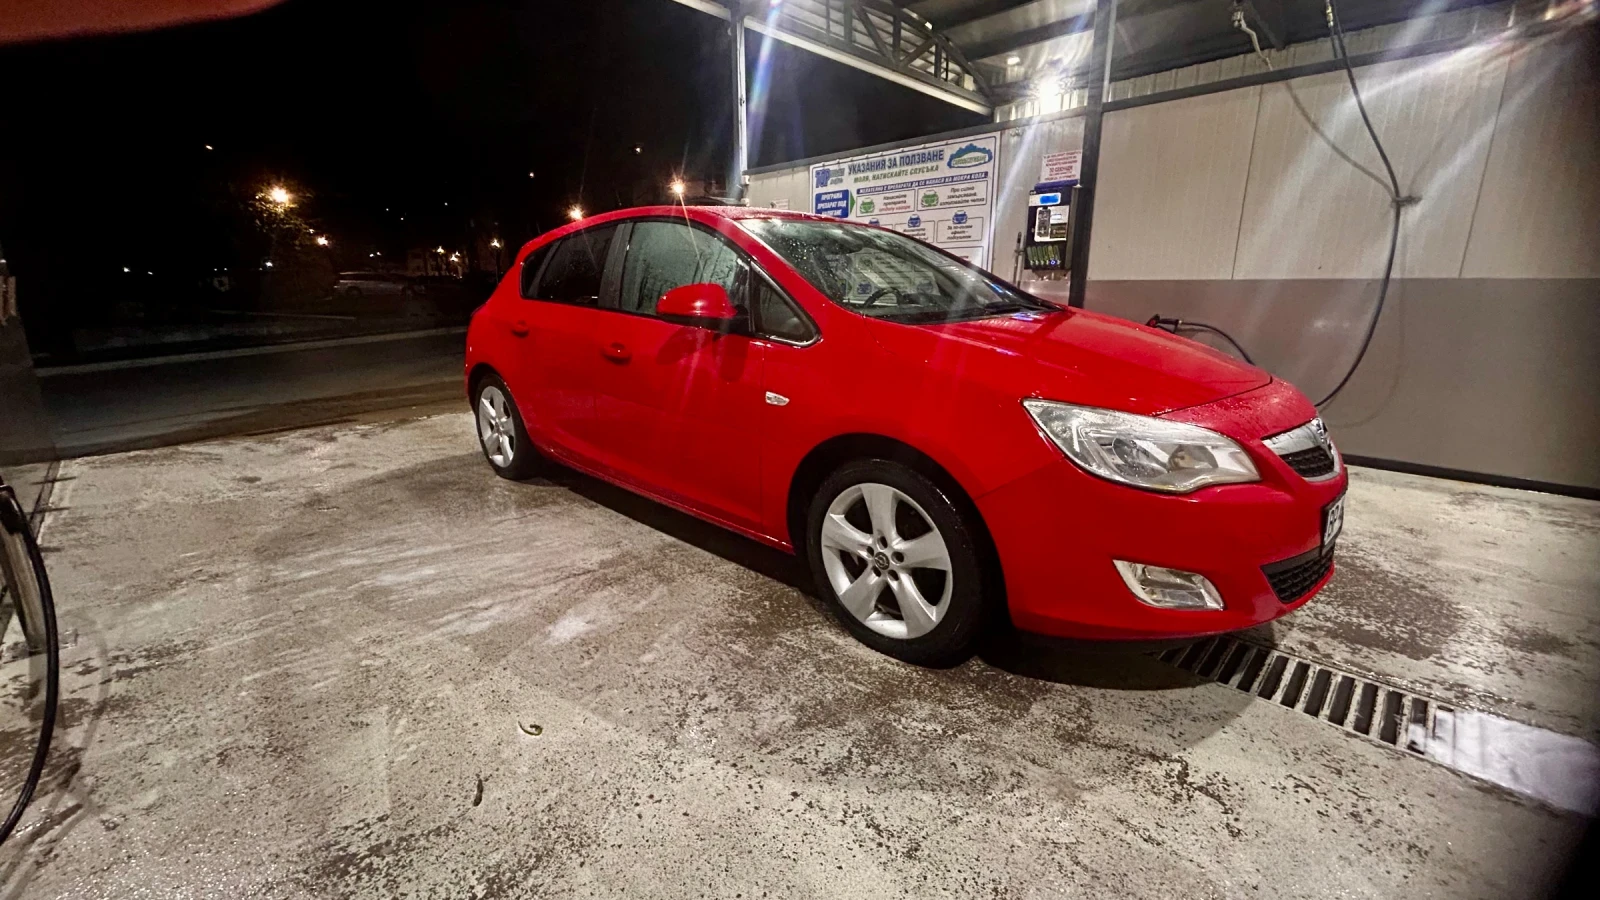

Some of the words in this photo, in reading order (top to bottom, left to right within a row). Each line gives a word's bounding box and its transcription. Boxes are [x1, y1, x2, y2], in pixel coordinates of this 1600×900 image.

[848, 161, 886, 175] УКАЗАНИЯ
[887, 158, 897, 170] ЗА
[899, 150, 944, 166] ПОЛЗВАНЕ
[872, 169, 908, 181] НАТИСКАЙТЕ
[909, 165, 939, 176] СПУСЪКА
[926, 177, 944, 185] НАНАСЯ
[821, 192, 842, 201] ПРОГРАМА
[817, 202, 837, 210] ПРЕПАРАТ
